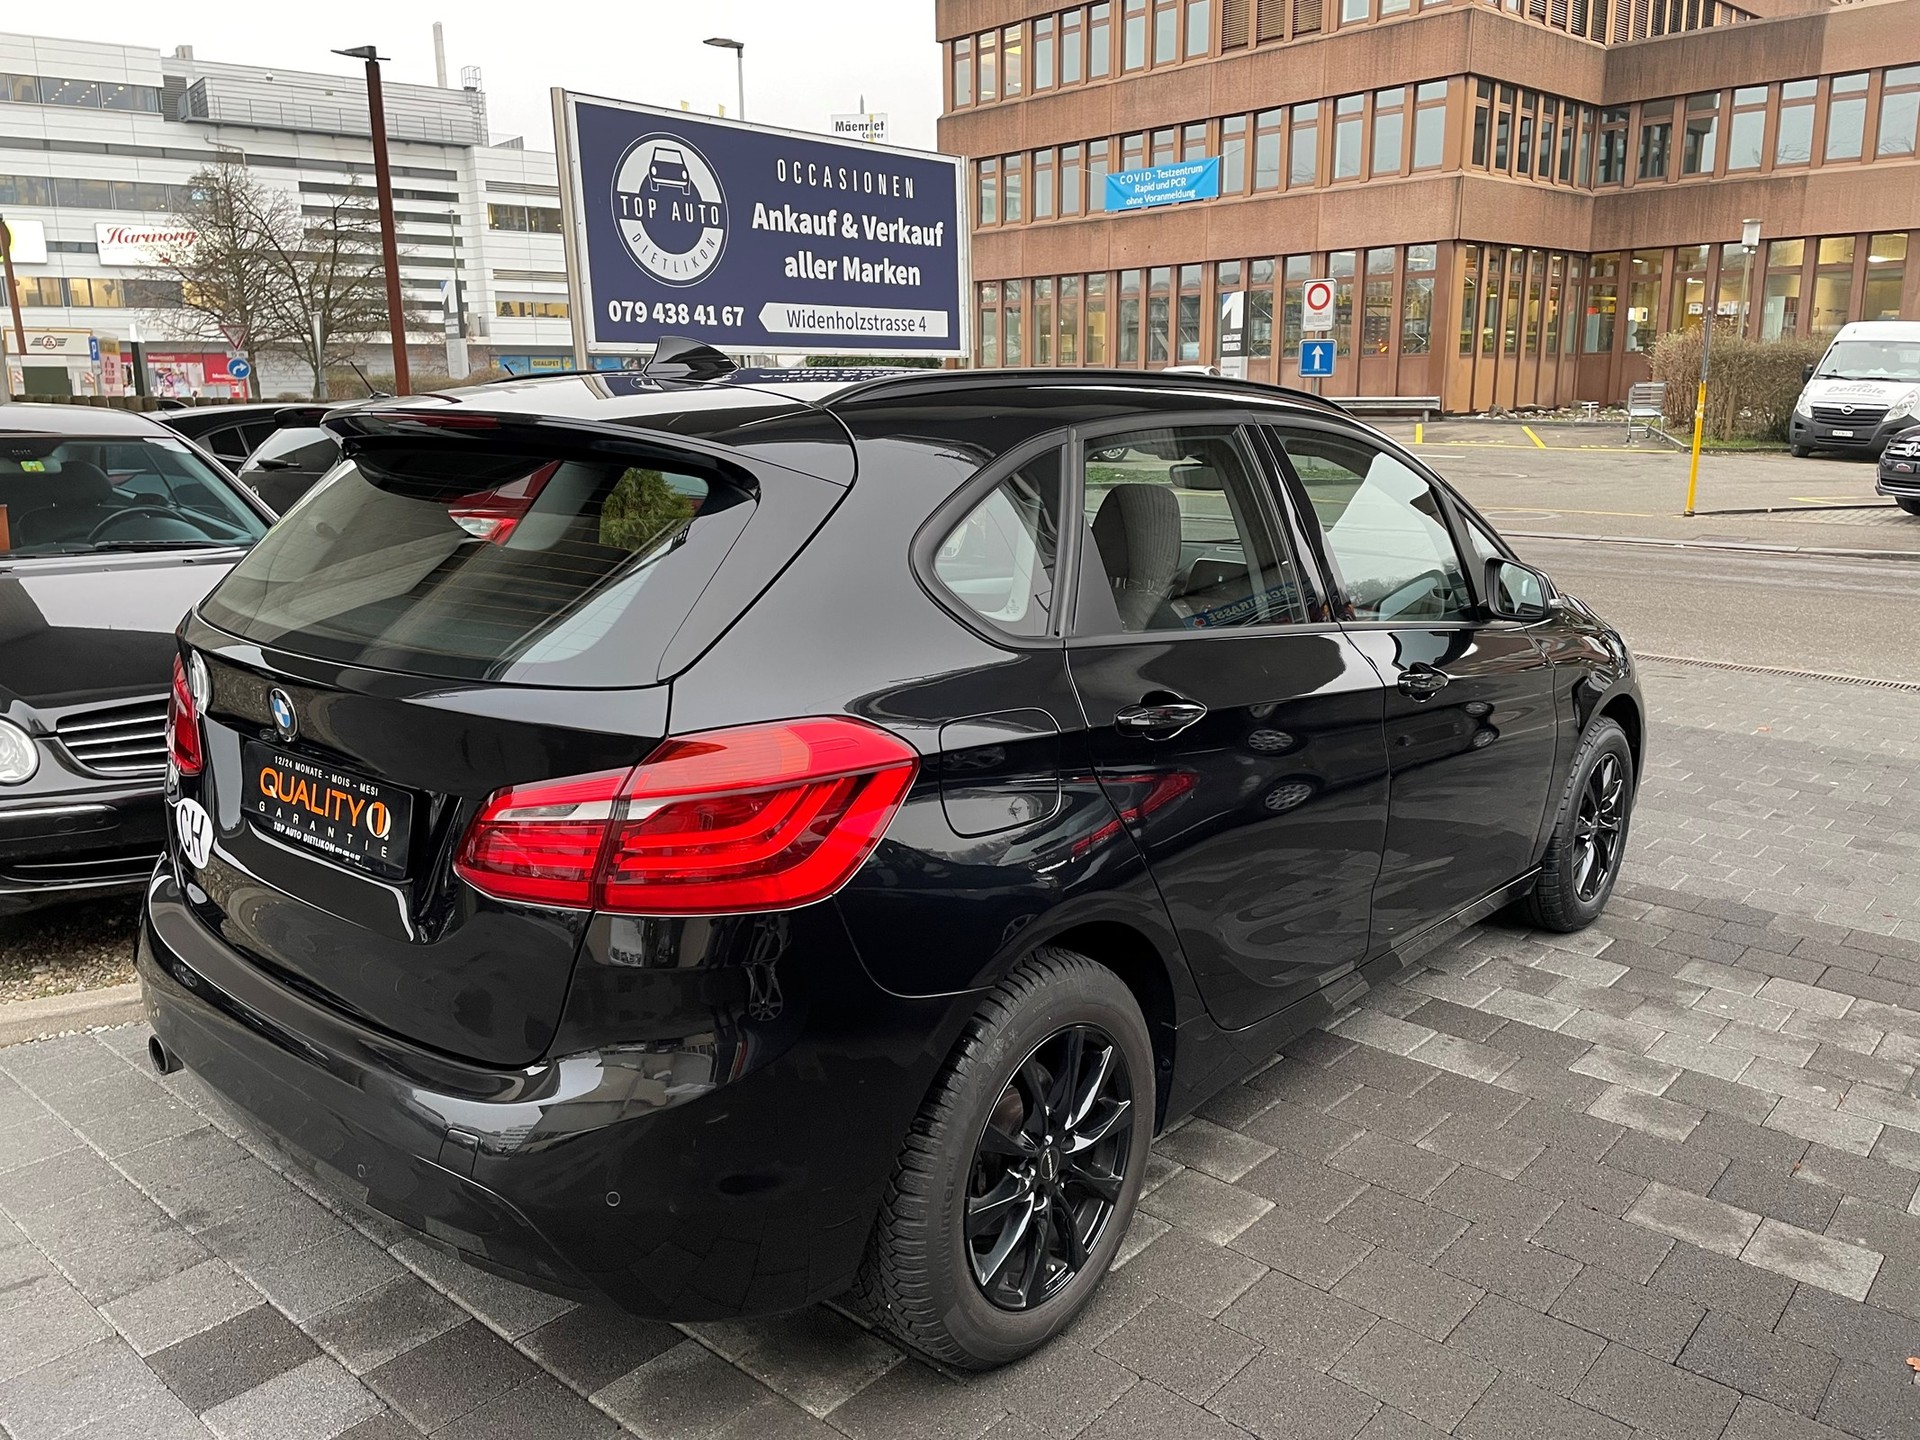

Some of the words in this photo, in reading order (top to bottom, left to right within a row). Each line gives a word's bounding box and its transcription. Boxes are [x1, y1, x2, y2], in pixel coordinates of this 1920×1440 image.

[777, 159, 914, 199] OCCASIONEN
[1135, 181, 1155, 194] Rapid
[1156, 180, 1169, 190] und
[1171, 177, 1186, 187] PCR
[620, 195, 657, 219] TOP
[672, 201, 719, 225] AUTO
[1126, 196, 1143, 206] ohne
[1144, 189, 1196, 203] Voranmeldung
[101, 227, 197, 248] Harmony
[752, 203, 837, 237] Ankauf
[841, 212, 859, 240] &
[862, 215, 944, 247] Verkauf
[632, 233, 716, 273] DIETLIKON
[784, 250, 838, 281] aller
[843, 256, 921, 286] Marken
[608, 301, 647, 324] 079
[652, 302, 690, 325] 438
[693, 305, 718, 326] 41
[721, 305, 745, 327] 67
[787, 309, 915, 333] Widenholzstrasse
[918, 316, 927, 332] 4
[274, 755, 293, 769] 12/24
[295, 762, 323, 779] MONATE
[331, 774, 351, 788] MOIS
[359, 782, 379, 797] MESI
[260, 767, 365, 827] QUALITY
[178, 804, 205, 864] CH
[258, 801, 388, 858] GARANTIE
[273, 821, 285, 834] TOP
[285, 826, 302, 841] AUTO
[302, 833, 336, 853] DIETLIKON
